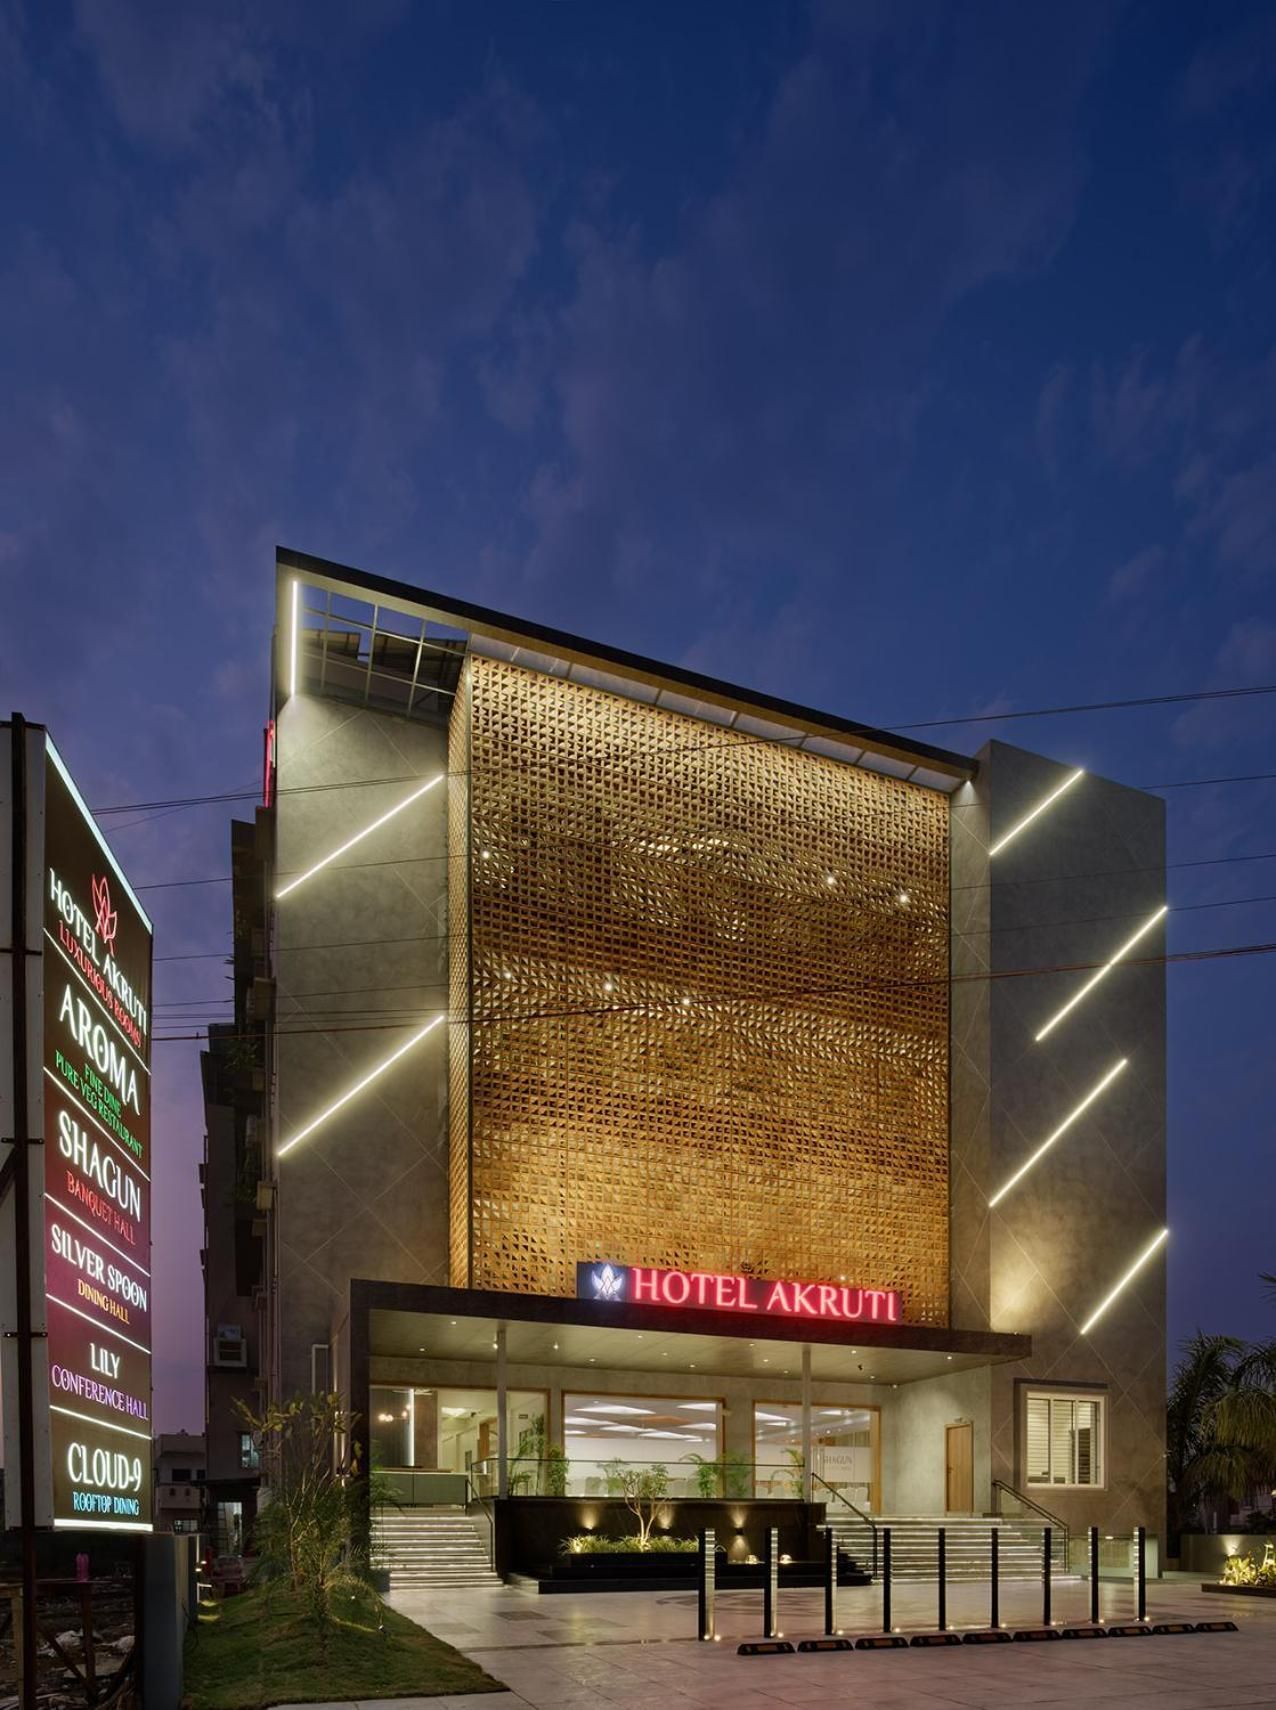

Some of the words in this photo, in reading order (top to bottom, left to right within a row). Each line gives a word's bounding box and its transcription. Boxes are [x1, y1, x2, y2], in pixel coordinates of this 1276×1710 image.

[50, 868, 100, 967] HOTEL
[103, 954, 148, 1036] AKRUTI
[59, 984, 141, 1116] AROMA
[55, 1049, 79, 1090] PURE
[80, 1076, 98, 1110] VEG
[98, 1097, 143, 1159] RESTAURANT
[84, 1063, 104, 1098] FINE
[59, 1110, 141, 1222] SHAGUN
[66, 1169, 113, 1224] BANQUET
[113, 1211, 137, 1246] HALL
[51, 1223, 106, 1285] SILVER
[107, 1264, 147, 1312] SPOON
[632, 1267, 758, 1310] HOTEL
[766, 1282, 897, 1321] AKRUTI
[78, 1279, 109, 1312] DINING
[109, 1297, 131, 1325] HALL
[90, 1342, 121, 1379] LILY
[51, 1364, 125, 1412] CONFERENCE
[125, 1395, 149, 1421] HALL
[67, 1442, 142, 1492] CLOUD-9
[72, 1491, 112, 1514] ROOFTOP
[113, 1496, 140, 1516] DINING
